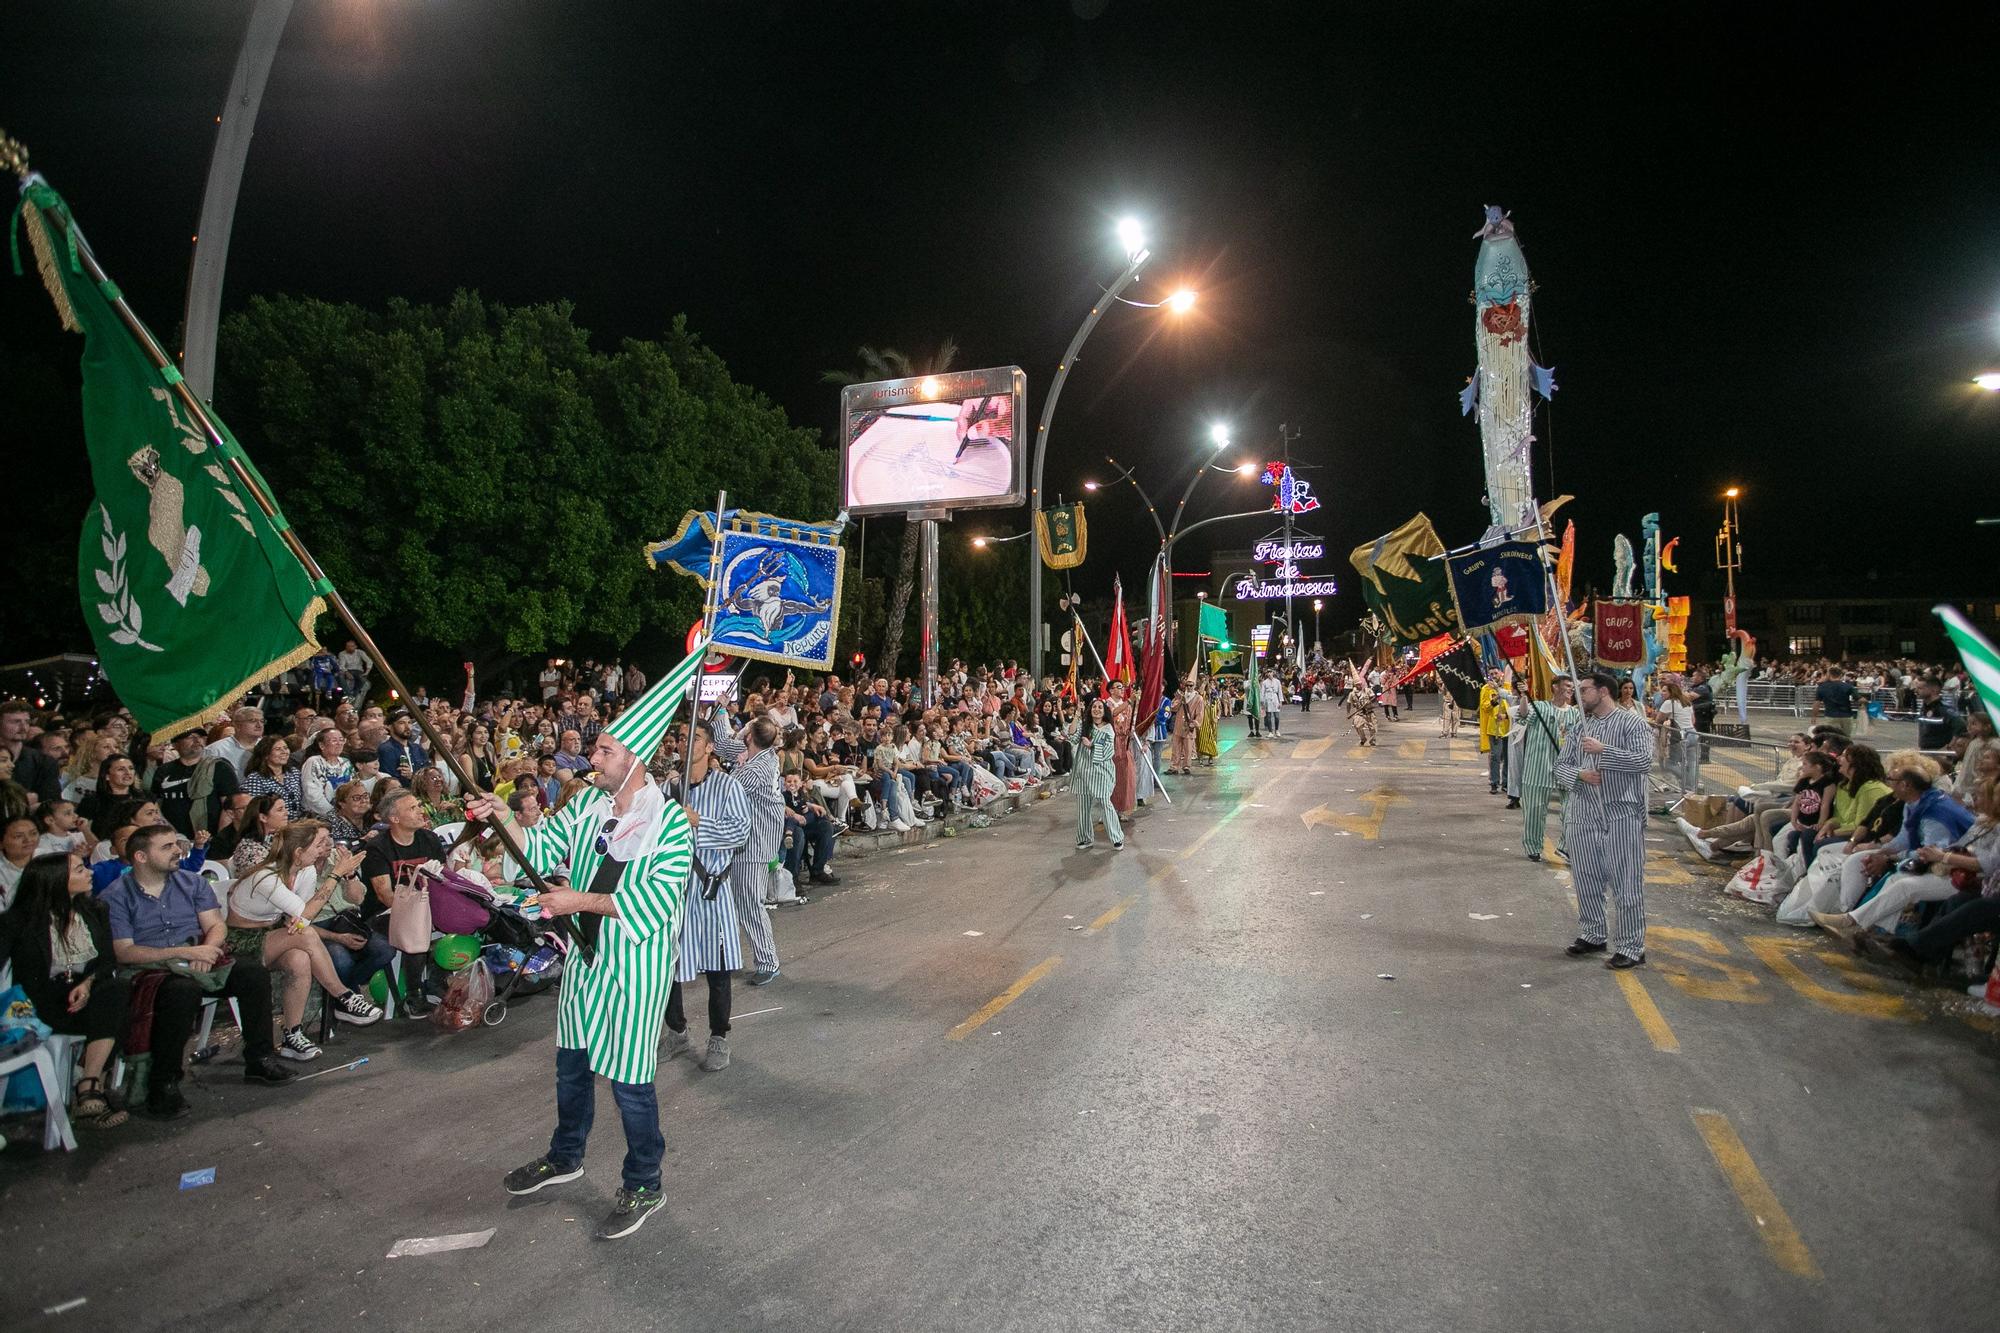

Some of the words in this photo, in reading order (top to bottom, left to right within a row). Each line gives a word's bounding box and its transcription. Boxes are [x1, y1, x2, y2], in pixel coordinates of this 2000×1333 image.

[1254, 542, 1323, 560] Fiestas
[1275, 561, 1300, 578] de
[1463, 560, 1485, 575] GRUPO
[1236, 579, 1337, 599] Primavera
[1605, 617, 1634, 629] GRUPO
[1607, 638, 1632, 650] BACO
[691, 679, 733, 687] ECEPTO
